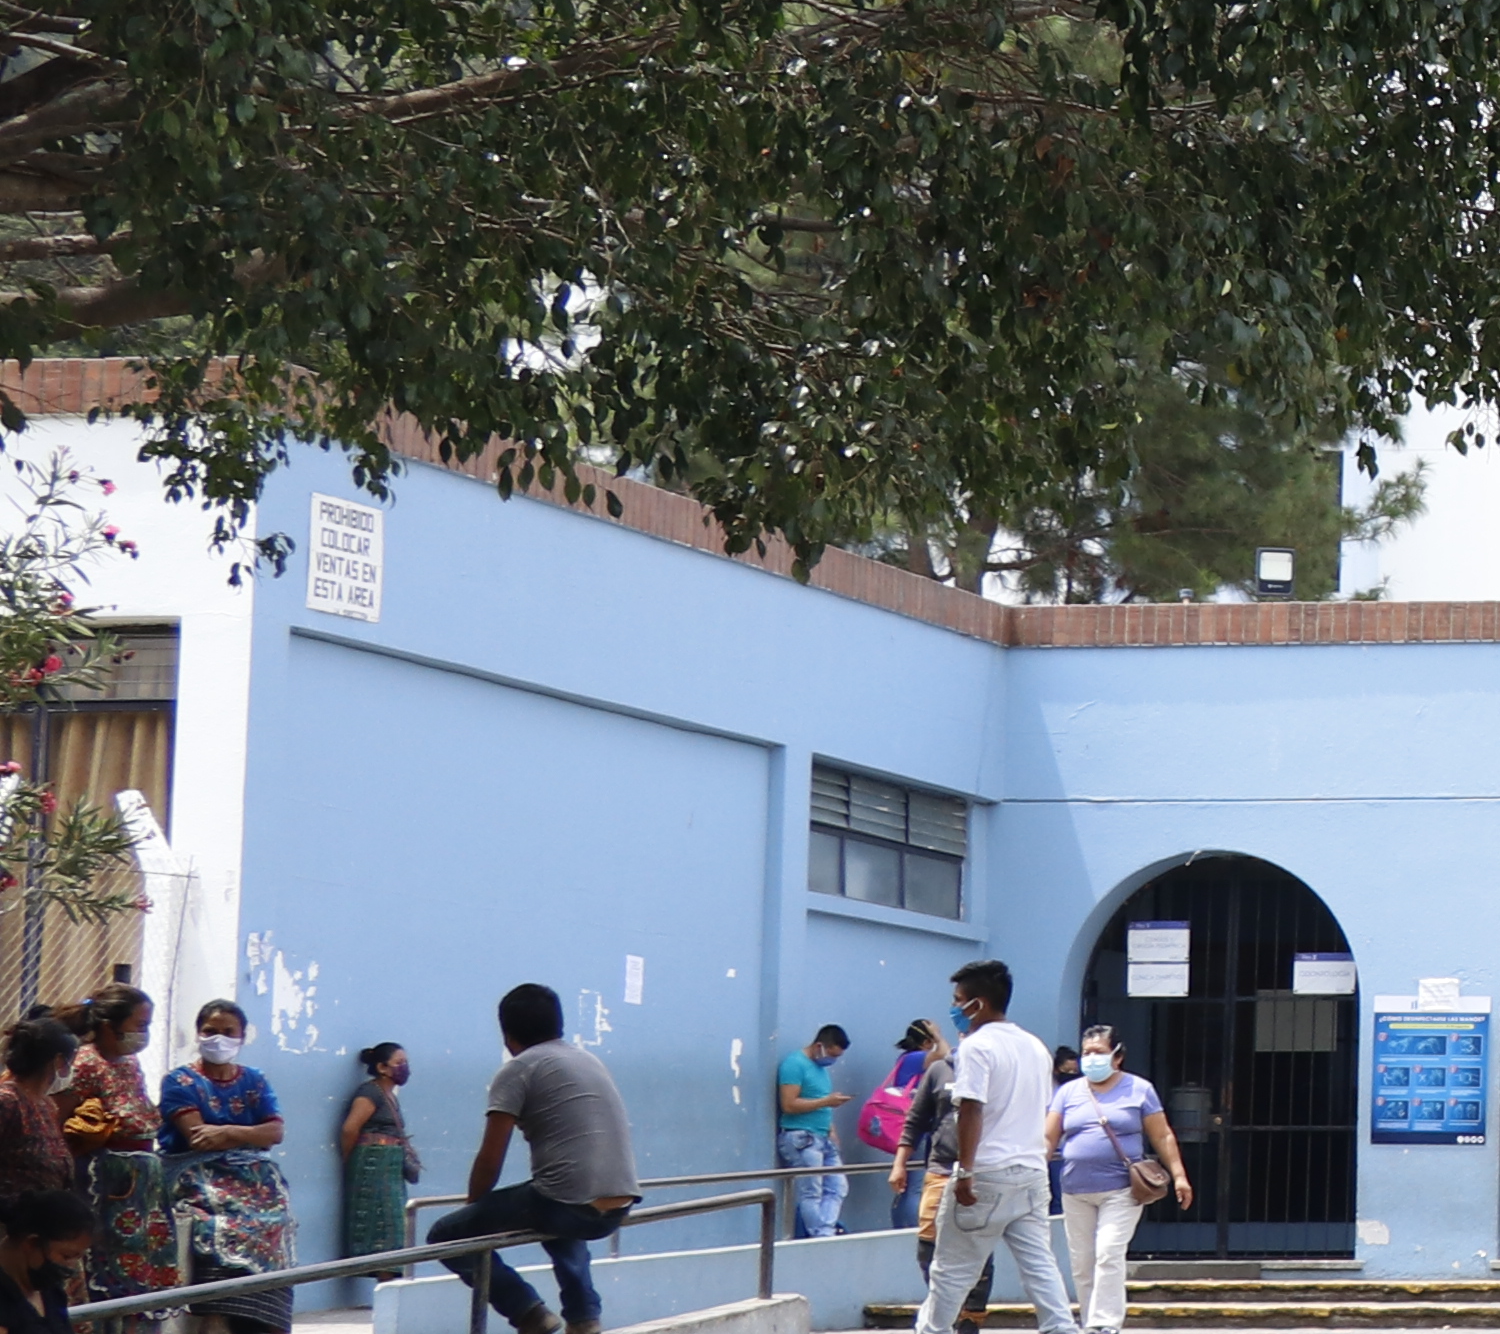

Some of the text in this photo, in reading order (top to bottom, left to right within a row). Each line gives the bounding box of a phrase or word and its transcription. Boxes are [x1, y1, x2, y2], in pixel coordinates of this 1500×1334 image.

[320, 501, 374, 533] PROHIBIDO
[321, 527, 370, 556] COLOCAR
[316, 552, 376, 584] VENTAS EN
[314, 577, 374, 609] ESTA AREA
